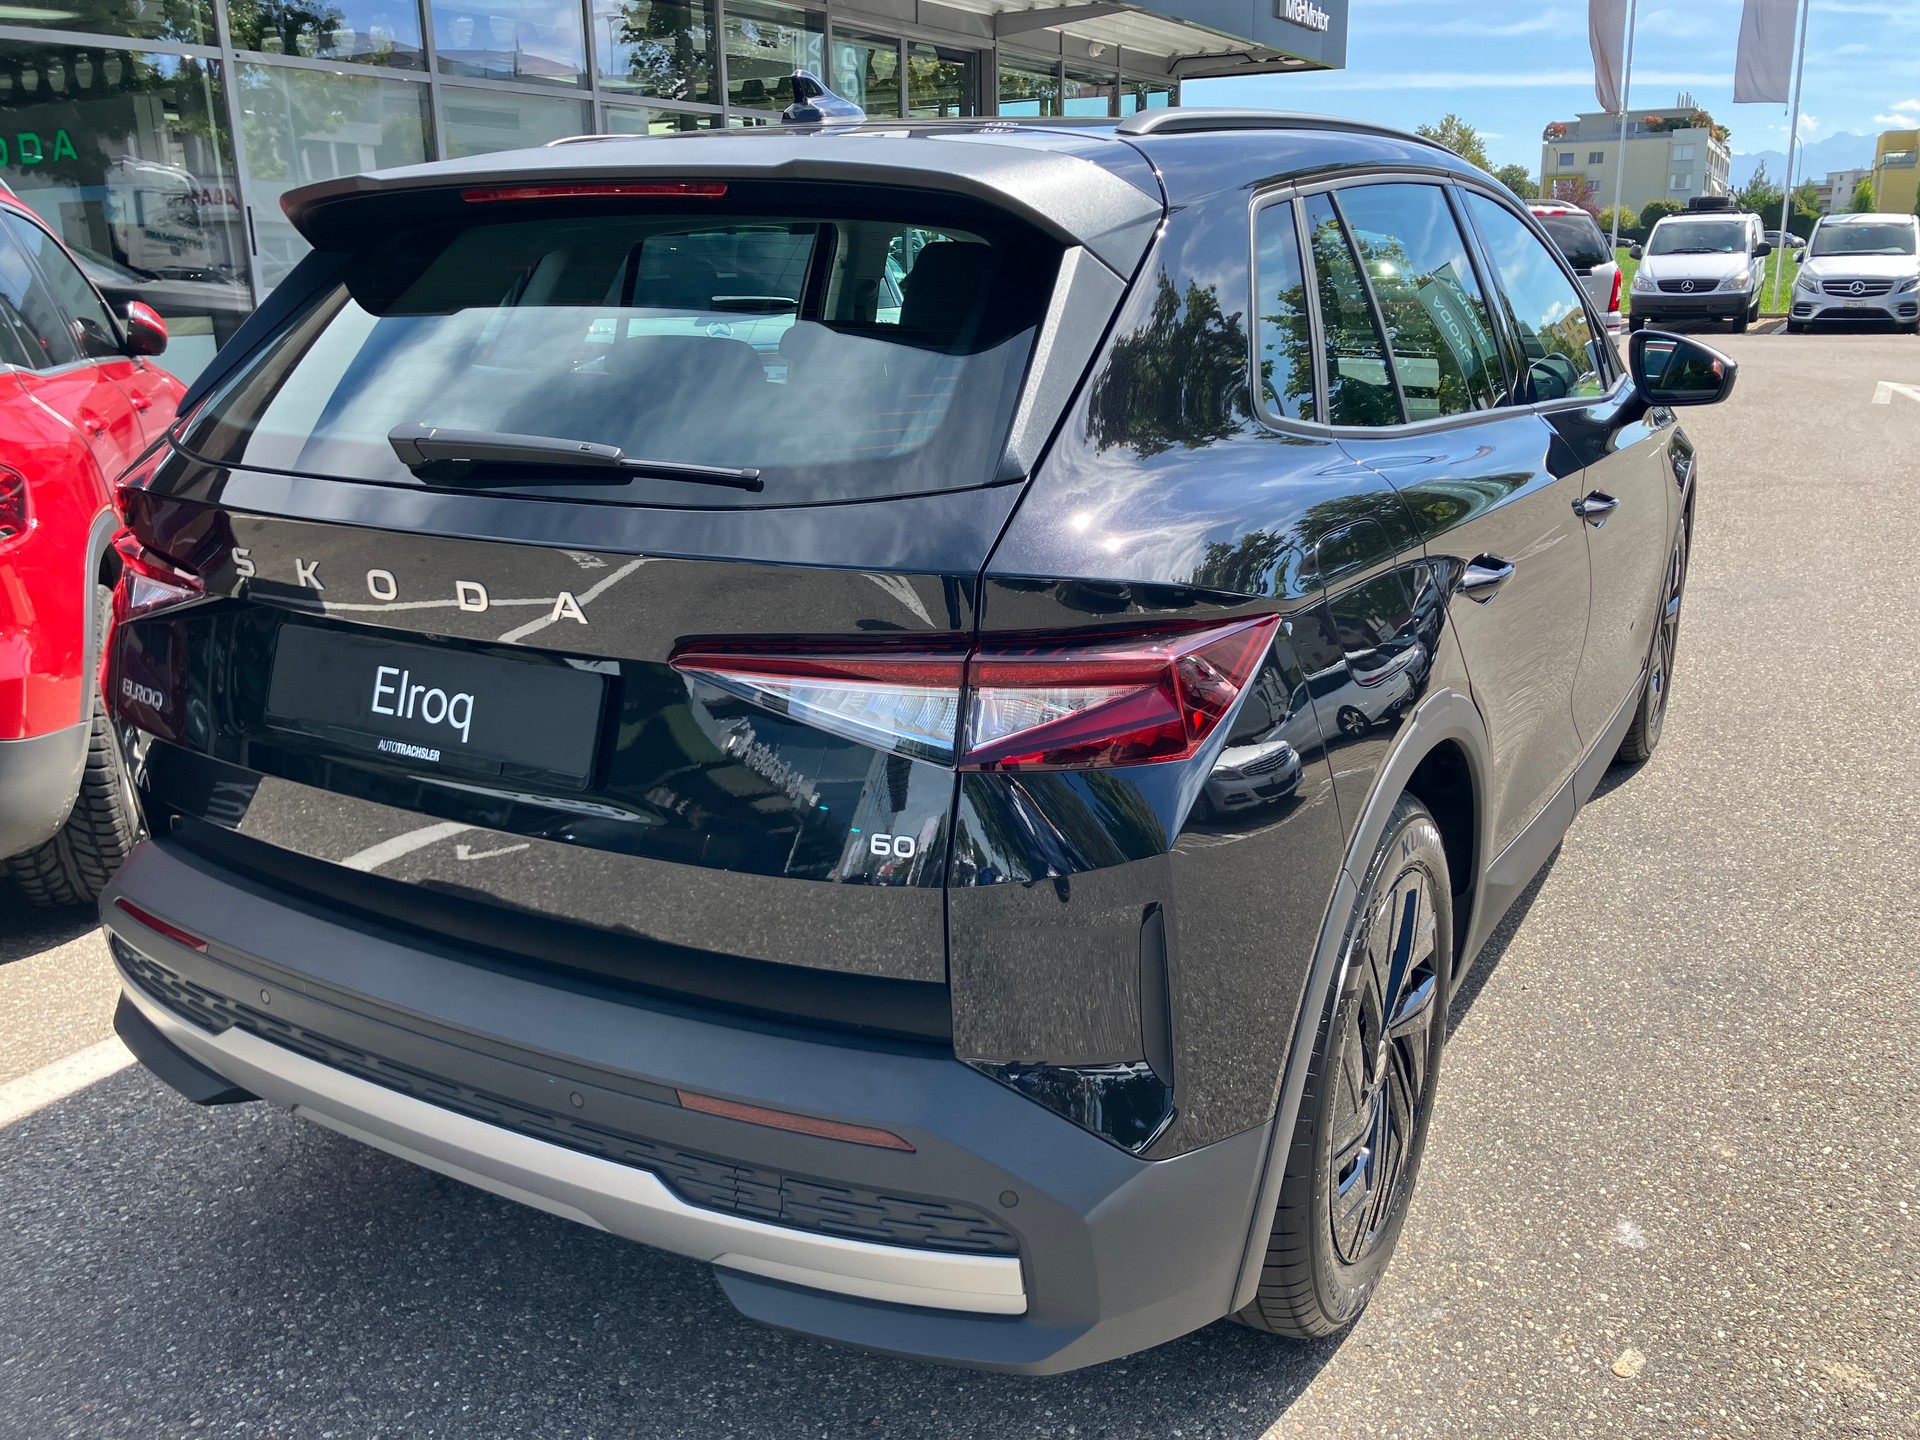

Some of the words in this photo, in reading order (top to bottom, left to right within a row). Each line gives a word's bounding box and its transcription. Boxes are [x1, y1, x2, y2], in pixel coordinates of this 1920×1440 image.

[1303, 0, 1330, 31] Motor
[231, 546, 590, 626] SKODA
[122, 677, 163, 711] ELROQ
[371, 665, 475, 744] Elroq
[378, 739, 441, 762] AUTOTRACHSLER
[870, 833, 916, 858] 60
